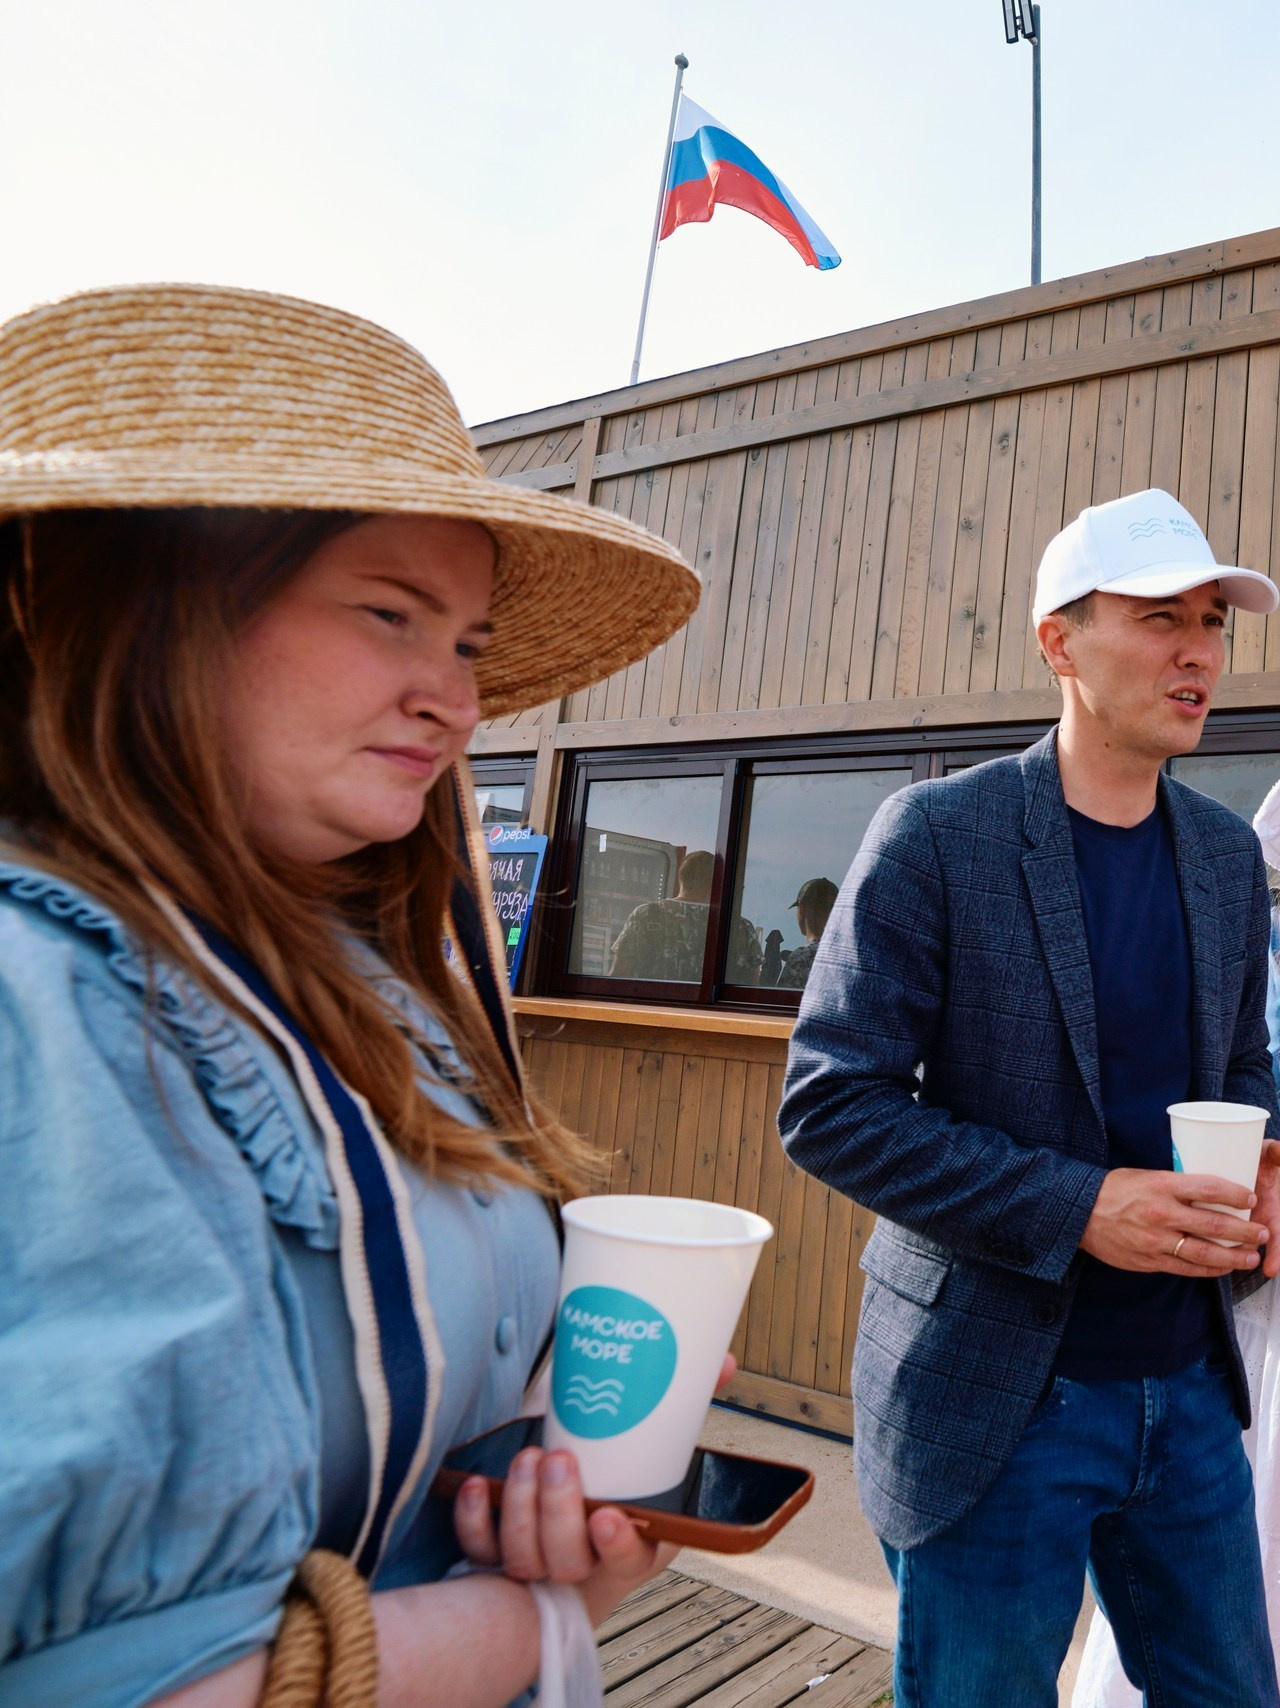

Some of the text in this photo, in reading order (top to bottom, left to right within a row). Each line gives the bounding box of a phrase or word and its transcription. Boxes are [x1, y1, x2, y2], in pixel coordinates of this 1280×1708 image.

[502, 827, 531, 842] pepsi
[491, 891, 529, 919] УРУЗА
[571, 1334, 633, 1365] МОРЕ
